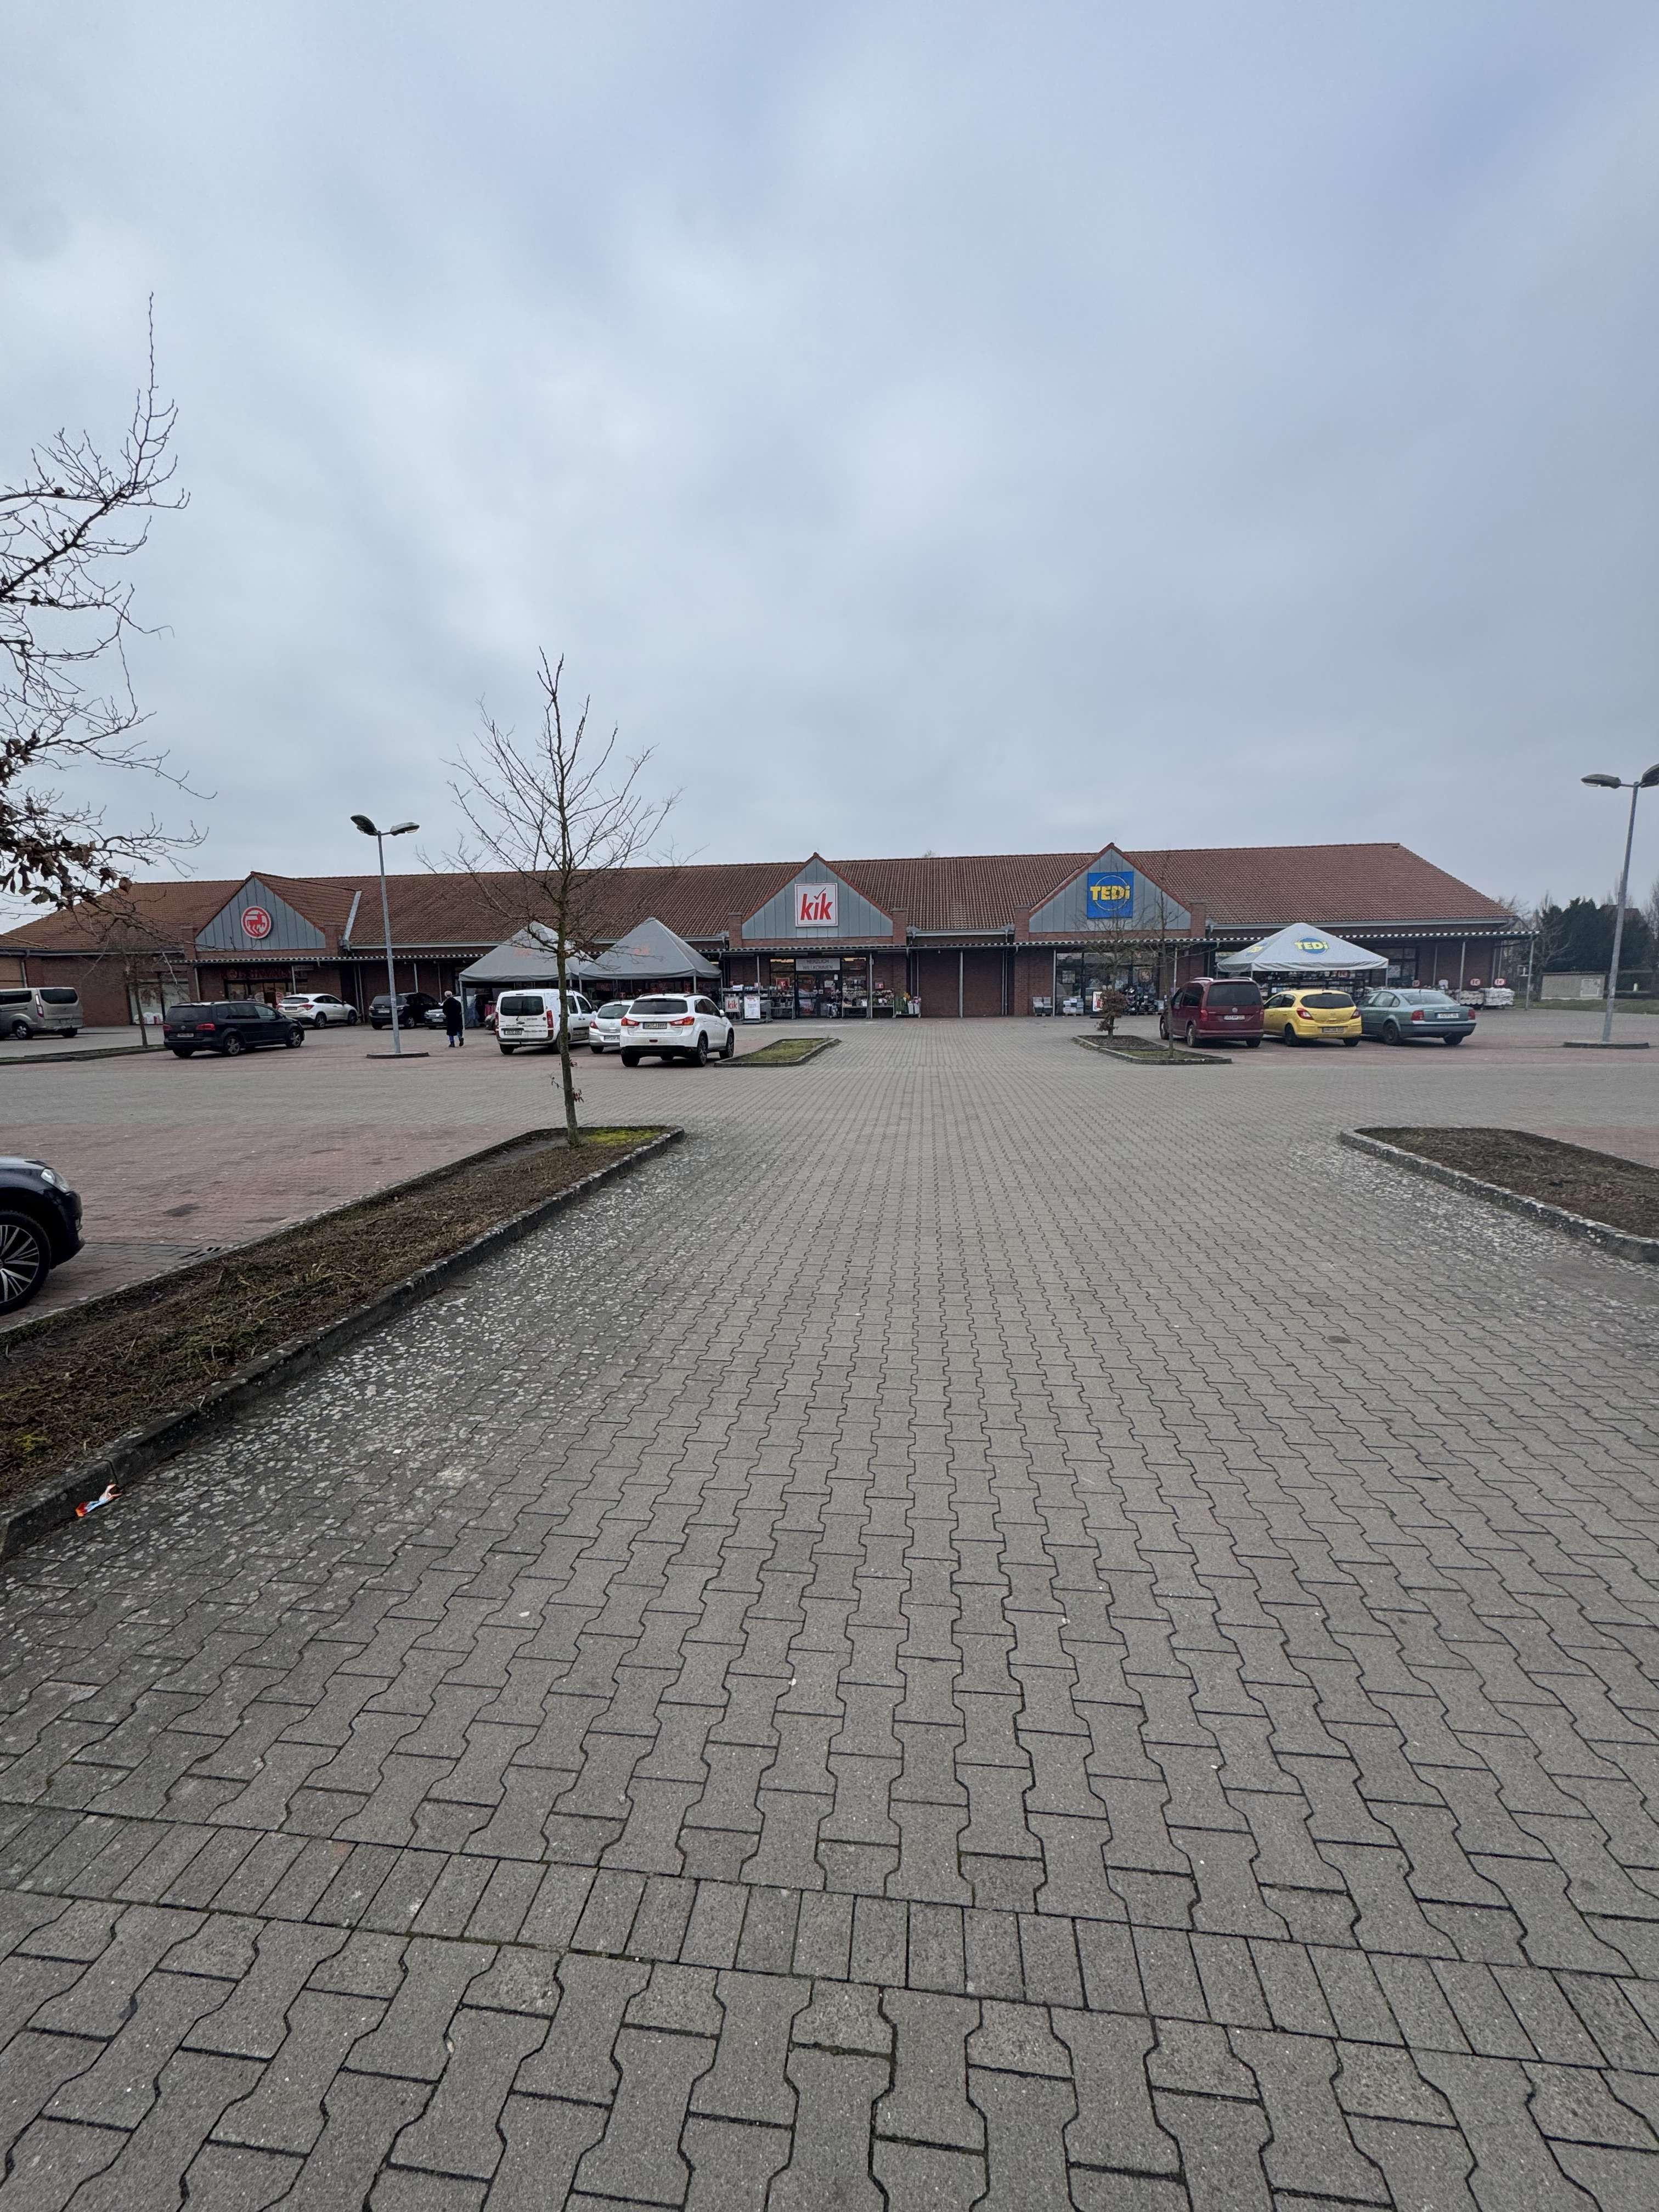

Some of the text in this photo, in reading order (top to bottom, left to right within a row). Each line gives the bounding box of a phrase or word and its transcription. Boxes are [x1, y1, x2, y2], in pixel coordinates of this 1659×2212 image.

[1090, 885, 1130, 900] TEDi
[800, 888, 833, 920] kik
[727, 1000, 737, 1009] kik
